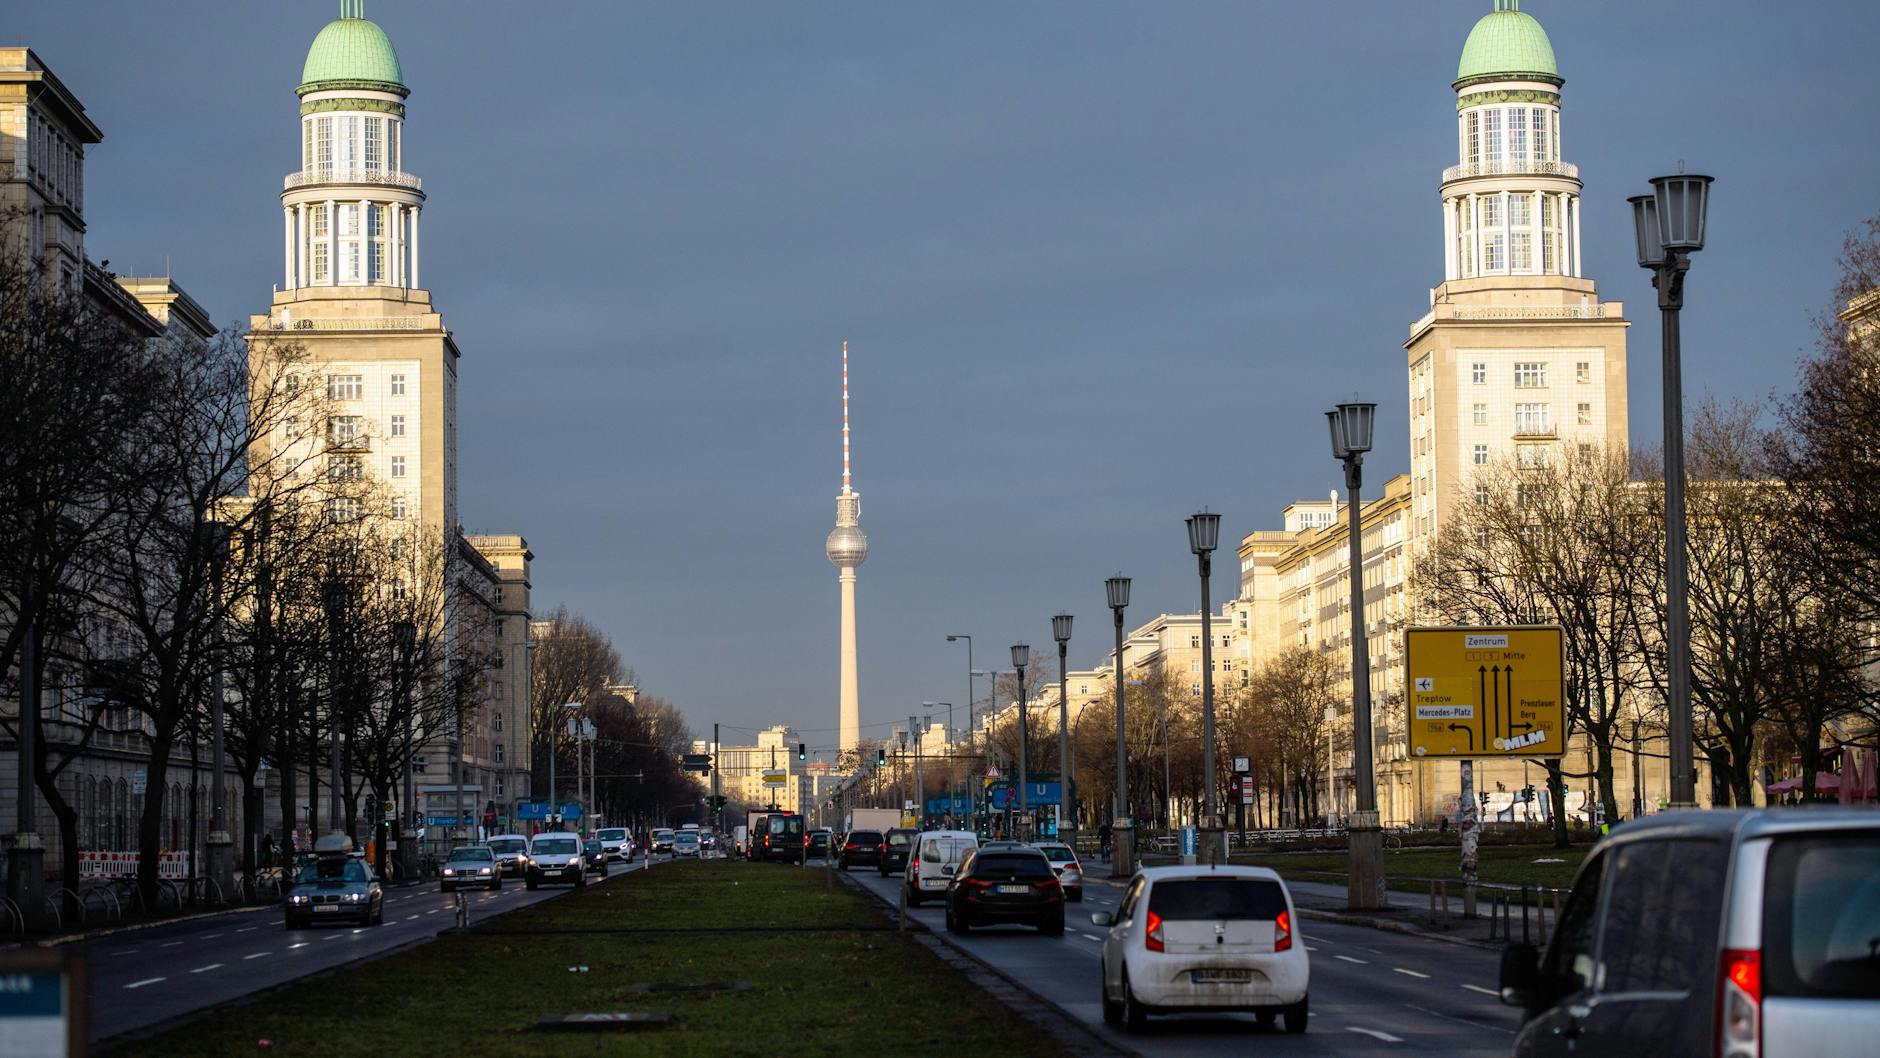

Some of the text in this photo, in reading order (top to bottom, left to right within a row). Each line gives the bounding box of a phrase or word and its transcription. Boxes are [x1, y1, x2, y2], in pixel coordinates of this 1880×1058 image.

[1467, 638, 1506, 646] Zentrum
[1503, 652, 1526, 660] Mitte
[1416, 695, 1451, 705] Treptow
[1418, 708, 1471, 717] Mercedes-Platz
[1520, 711, 1536, 720] Berg
[1504, 730, 1546, 751] MLM
[1037, 784, 1046, 796] U
[955, 799, 961, 807] U
[532, 803, 539, 813] U
[560, 806, 566, 814] U
[428, 817, 435, 826] U
